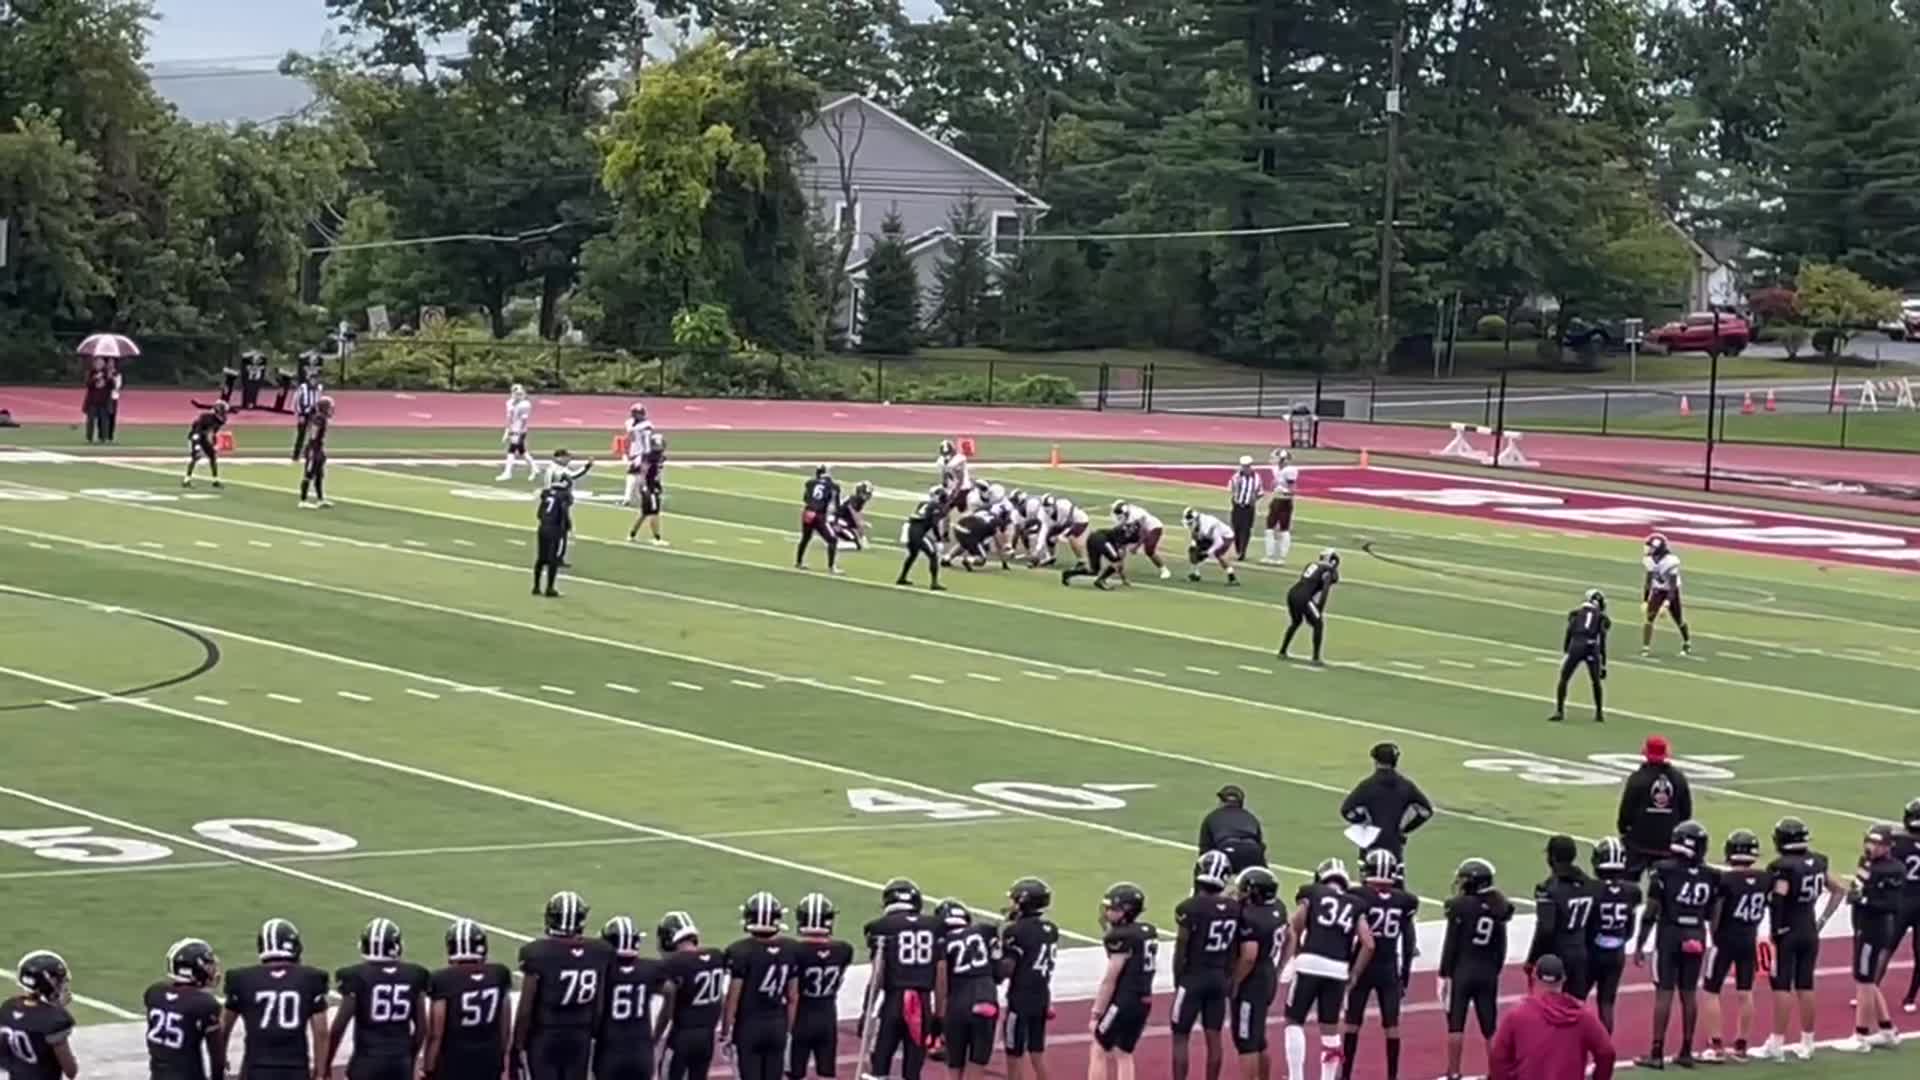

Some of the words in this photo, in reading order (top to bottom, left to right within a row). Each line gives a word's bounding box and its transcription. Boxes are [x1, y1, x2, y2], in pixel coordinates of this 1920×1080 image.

[812, 484, 825, 500] 6
[1676, 882, 1710, 905] 40
[1733, 892, 1765, 921] 48
[1317, 898, 1353, 934] 34
[1370, 907, 1401, 938] 26
[1472, 917, 1494, 945] 9
[1567, 897, 1593, 930] 77
[1600, 903, 1627, 929] 55
[899, 930, 934, 965] 88
[946, 933, 990, 974] 23
[559, 970, 597, 1006] 78
[692, 969, 723, 1006] 20
[759, 964, 787, 997] 41
[254, 991, 300, 1029] 70
[370, 984, 412, 1023] 65
[461, 988, 499, 1026] 57
[611, 984, 647, 1020] 61
[148, 1009, 185, 1049] 25
